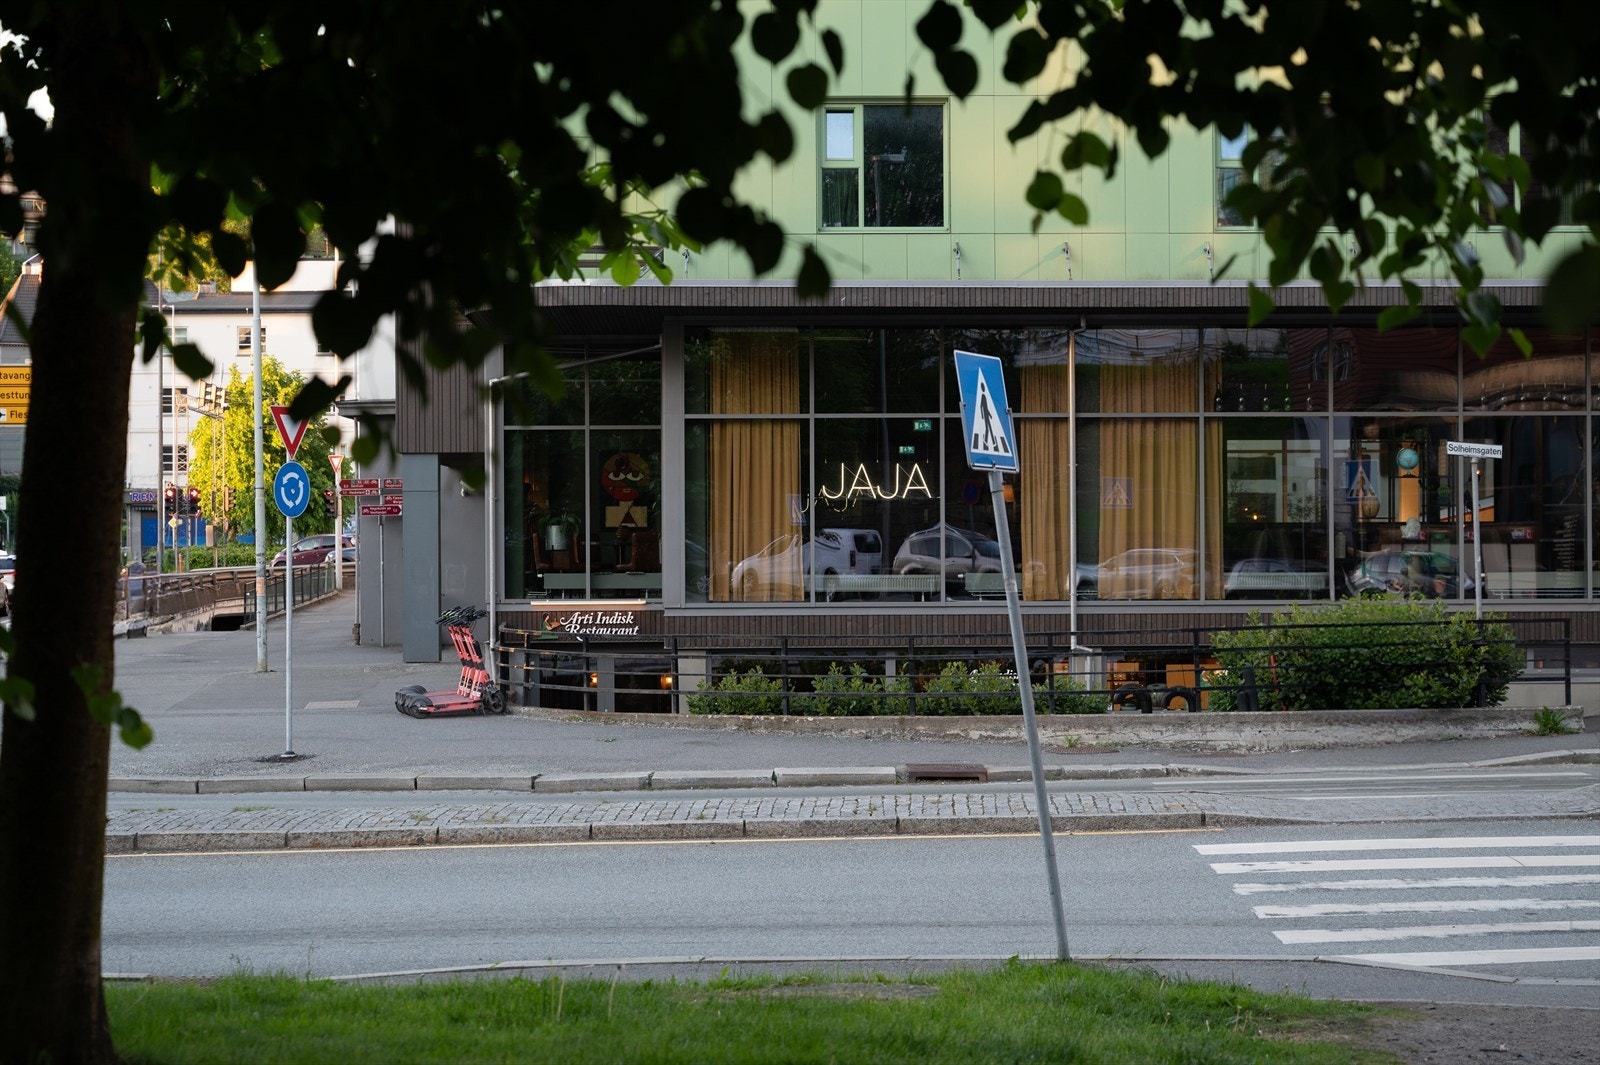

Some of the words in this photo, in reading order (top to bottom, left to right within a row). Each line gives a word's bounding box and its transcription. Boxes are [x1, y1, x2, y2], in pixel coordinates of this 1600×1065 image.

[1448, 443, 1502, 456] Solheimsgaten
[822, 462, 932, 499] JAJA
[560, 611, 594, 625] Arti
[595, 611, 635, 624] Indisk
[565, 623, 640, 636] Restaurant
